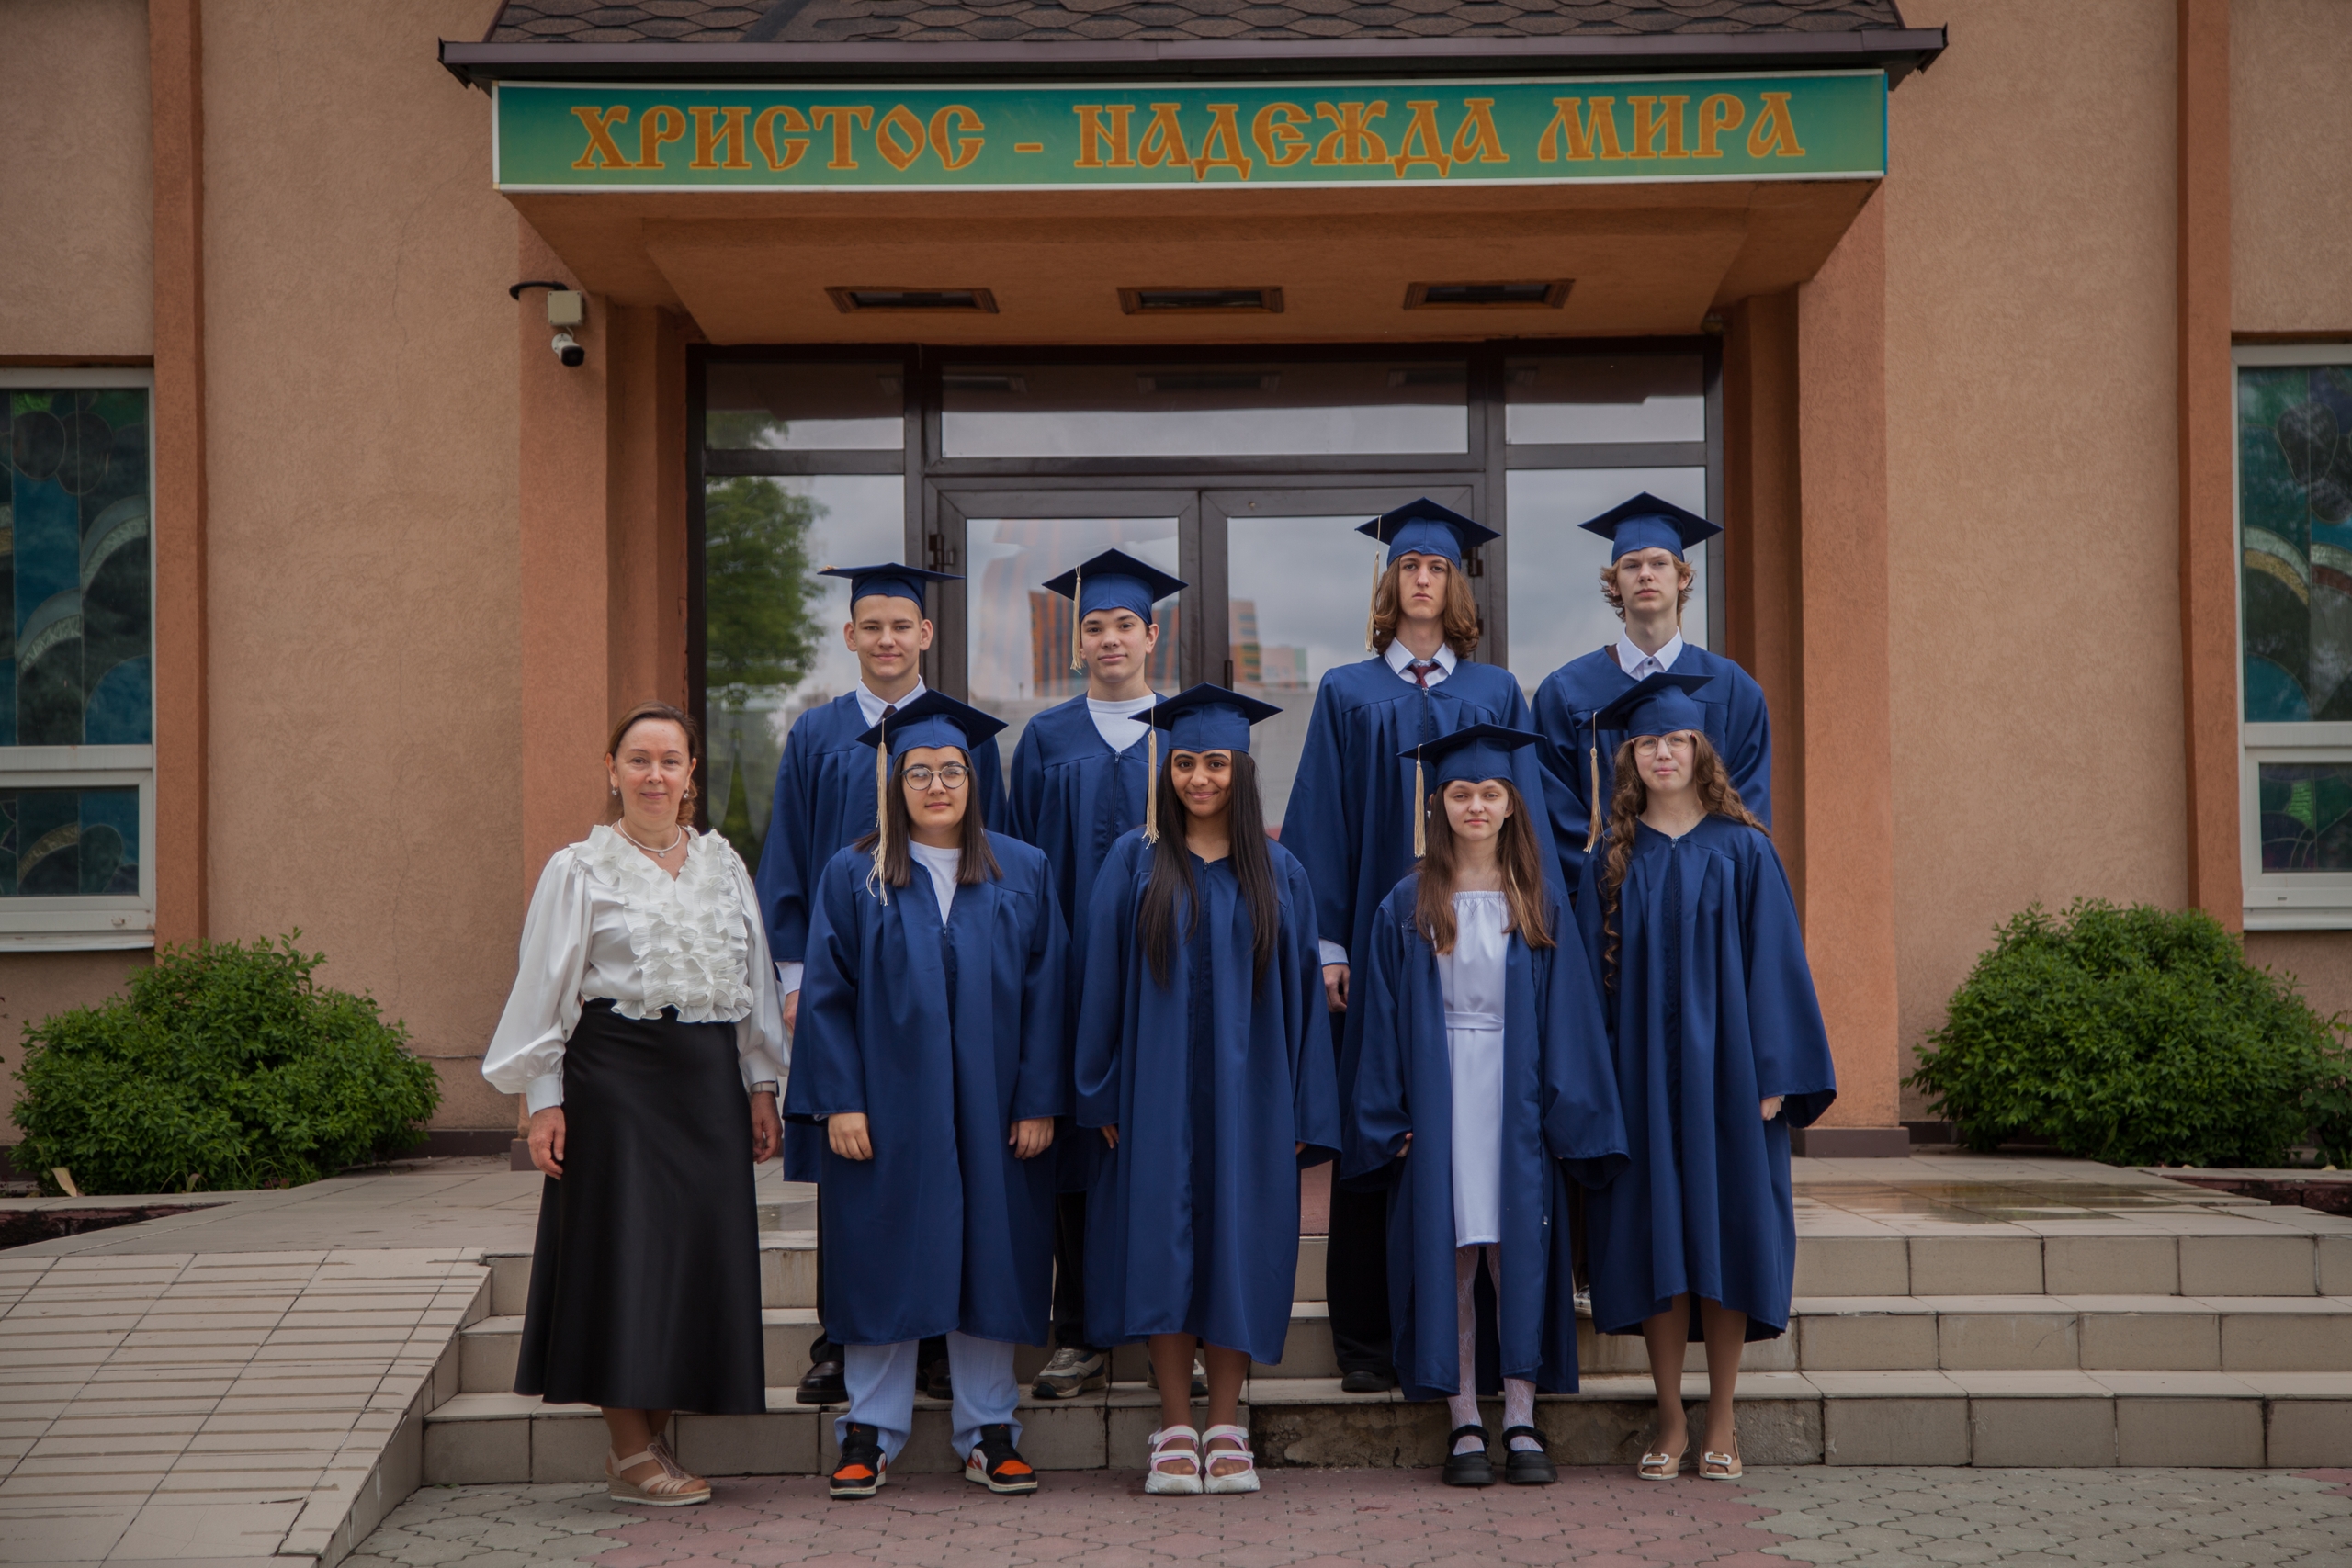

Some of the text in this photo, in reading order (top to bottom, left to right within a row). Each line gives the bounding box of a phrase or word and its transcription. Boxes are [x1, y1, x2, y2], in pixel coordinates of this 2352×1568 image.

[571, 93, 1806, 182] ХРИСТОС - НАДЕЖДА МИРА
